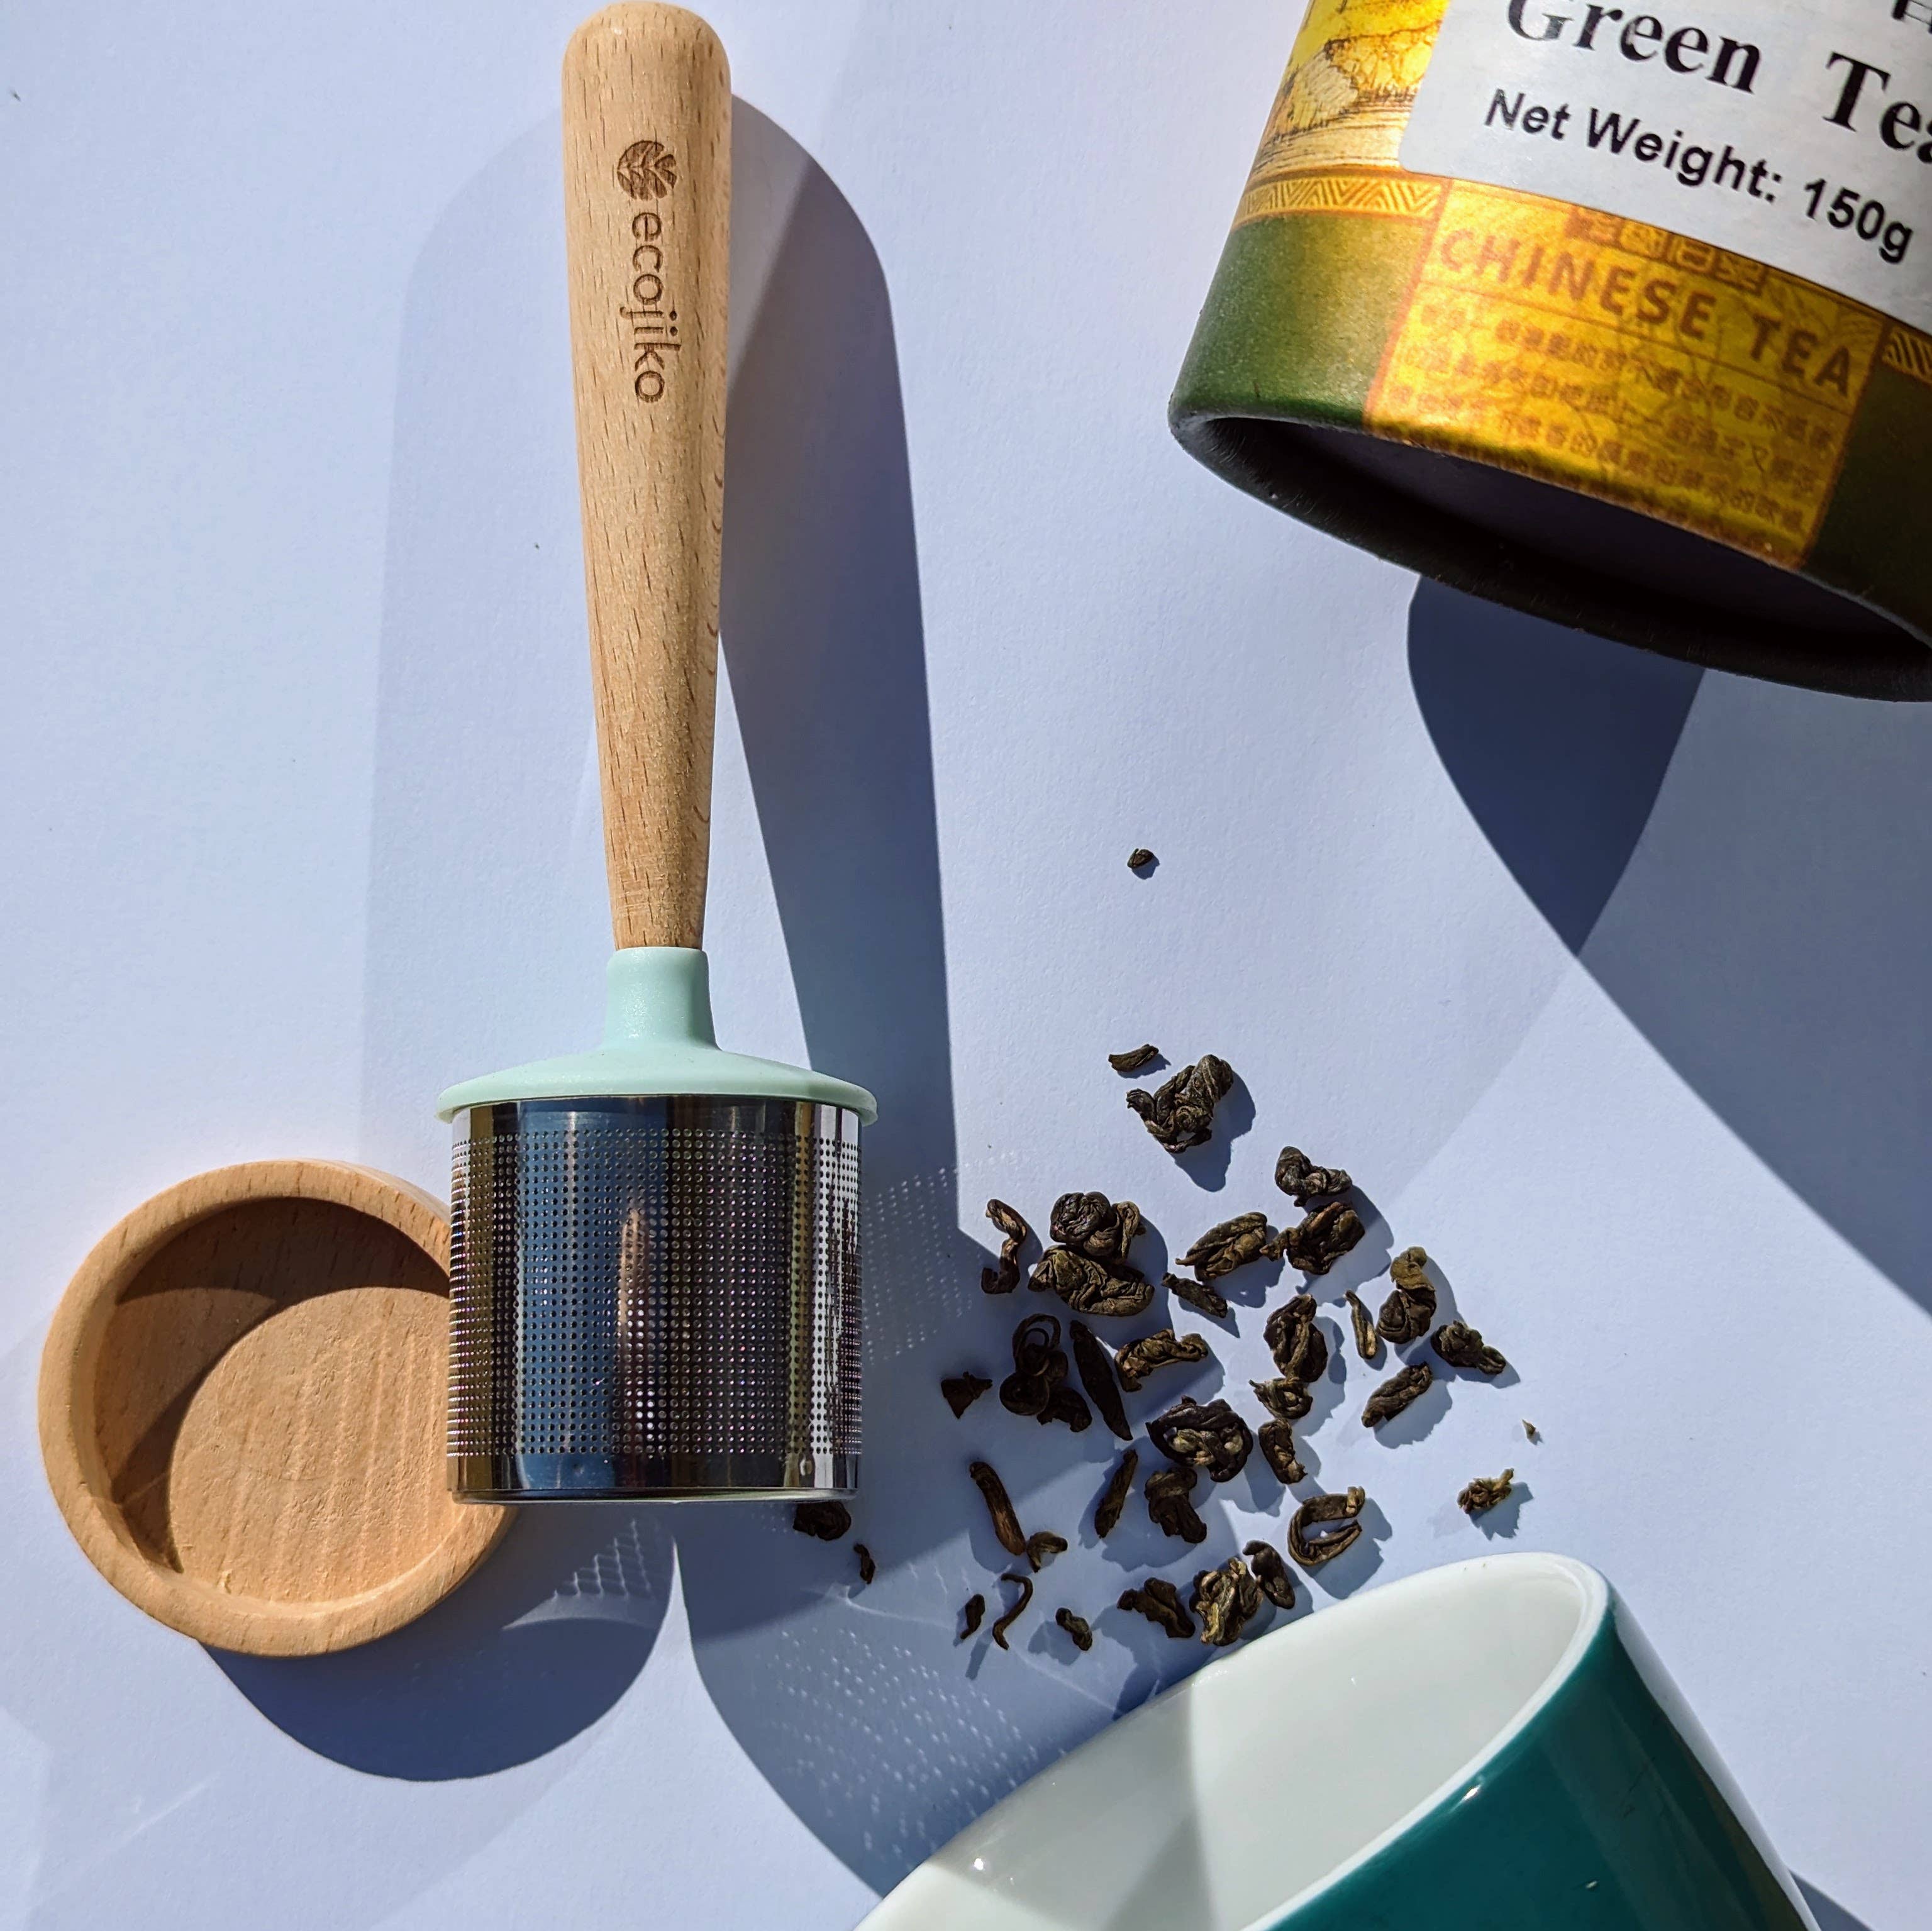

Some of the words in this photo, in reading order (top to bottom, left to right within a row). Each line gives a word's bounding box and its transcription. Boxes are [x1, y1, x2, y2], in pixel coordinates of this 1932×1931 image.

[1507, 0, 1762, 93] Green
[1485, 88, 1571, 140] Net
[1585, 108, 1784, 202] Weight:
[1805, 178, 1913, 264] 150g
[619, 212, 682, 403] ecojiko
[1439, 230, 1718, 338] CHINESE
[1748, 313, 1852, 396] TEA
